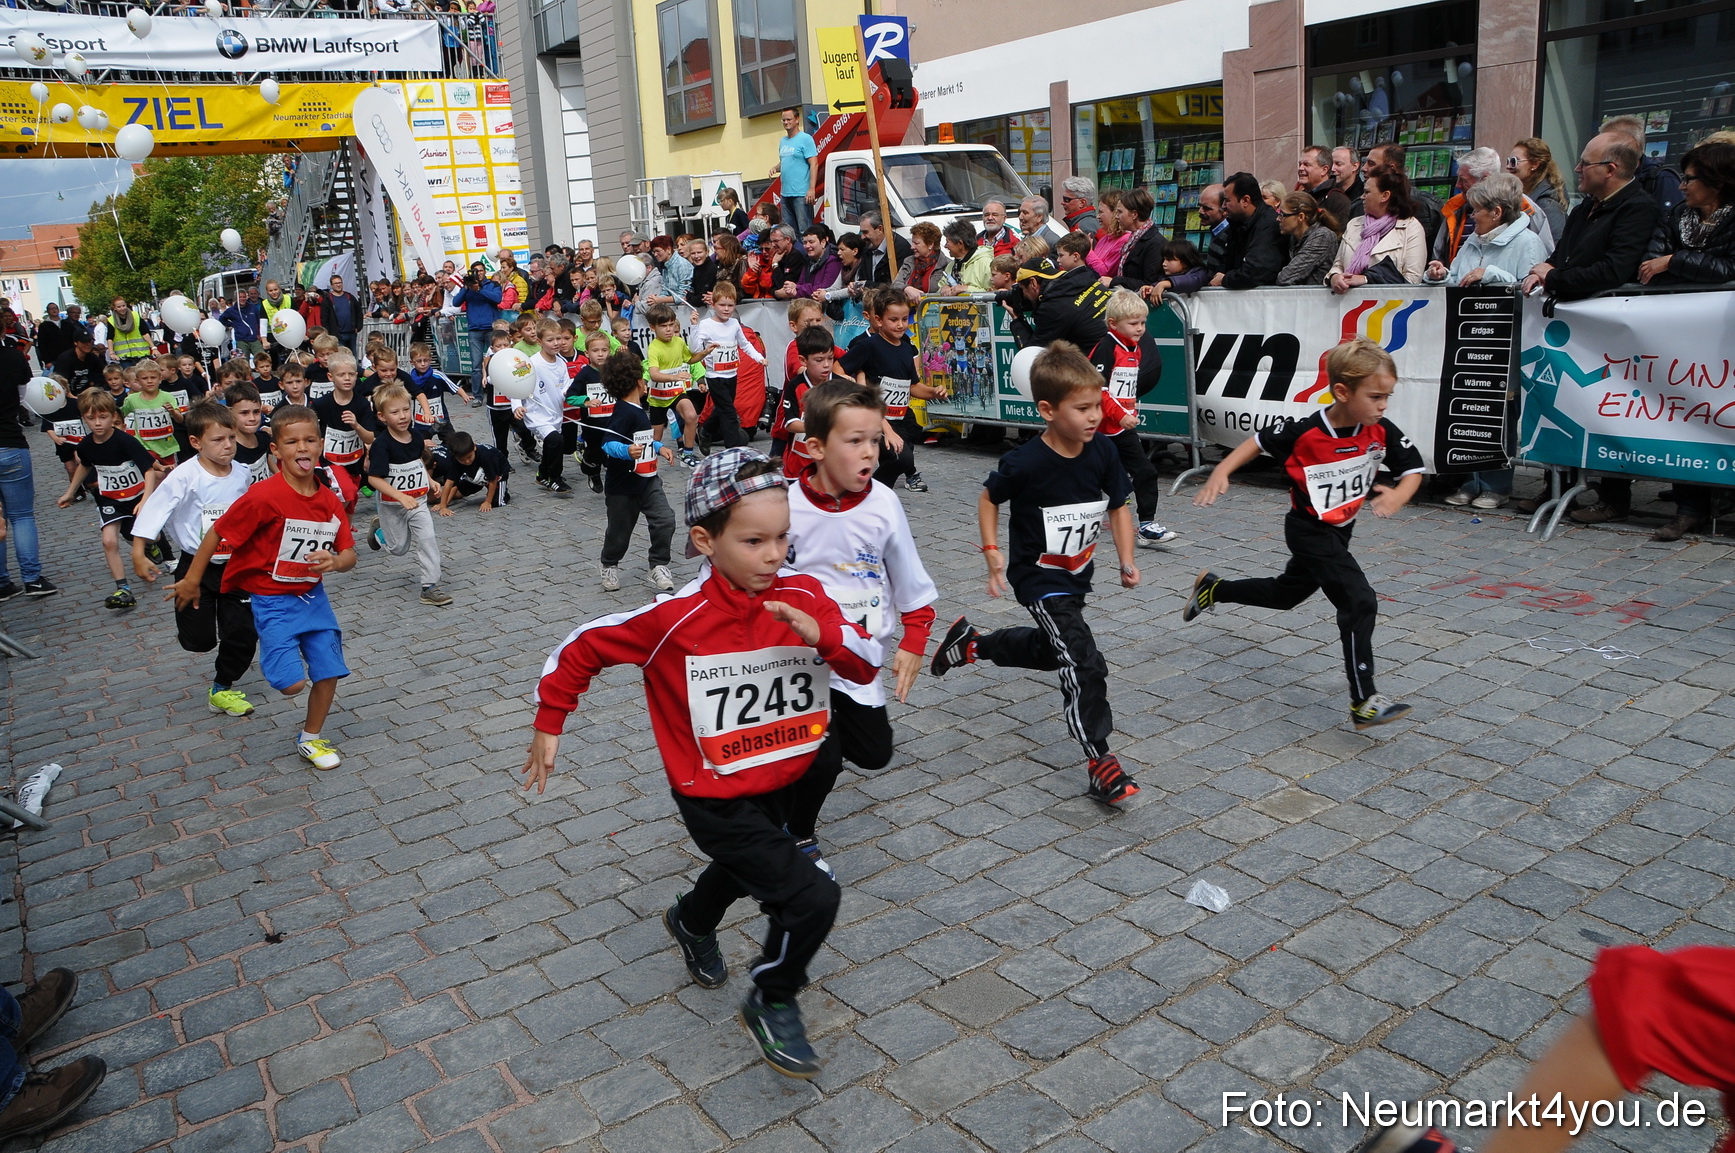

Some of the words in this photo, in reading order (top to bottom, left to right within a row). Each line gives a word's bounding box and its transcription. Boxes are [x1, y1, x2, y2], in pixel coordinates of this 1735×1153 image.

[256, 37, 308, 53] BMW
[313, 37, 399, 56] Laufsport
[822, 50, 858, 68] Jugend
[835, 67, 855, 80] lauf
[918, 88, 937, 101] nterer
[937, 83, 955, 98] Markt
[955, 82, 964, 93] 15
[123, 97, 224, 130] ZIEL
[273, 113, 320, 122] Neumarkter
[1474, 302, 1498, 310] Strom
[947, 316, 971, 329] erdgas
[1470, 326, 1495, 335] Erdgas
[1466, 352, 1494, 361] Wasser
[1463, 378, 1492, 388] Wärme
[1005, 405, 1026, 417] Miet
[1026, 407, 1034, 417] &
[1461, 403, 1490, 413] Freizeit
[140, 414, 168, 428] 7134
[1453, 428, 1493, 439] Stadtbusse
[330, 437, 360, 453] 7174
[1597, 446, 1710, 470] Service-Line:
[102, 471, 139, 491] 7390
[1307, 470, 1337, 482] PARTL
[1046, 513, 1078, 523] PARTL
[286, 525, 312, 535] PARTL
[1057, 520, 1101, 554] 713
[690, 666, 739, 682] PARTL
[741, 656, 808, 675] Neumarkt
[705, 672, 815, 732] 7243
[721, 724, 810, 759] sebastian
